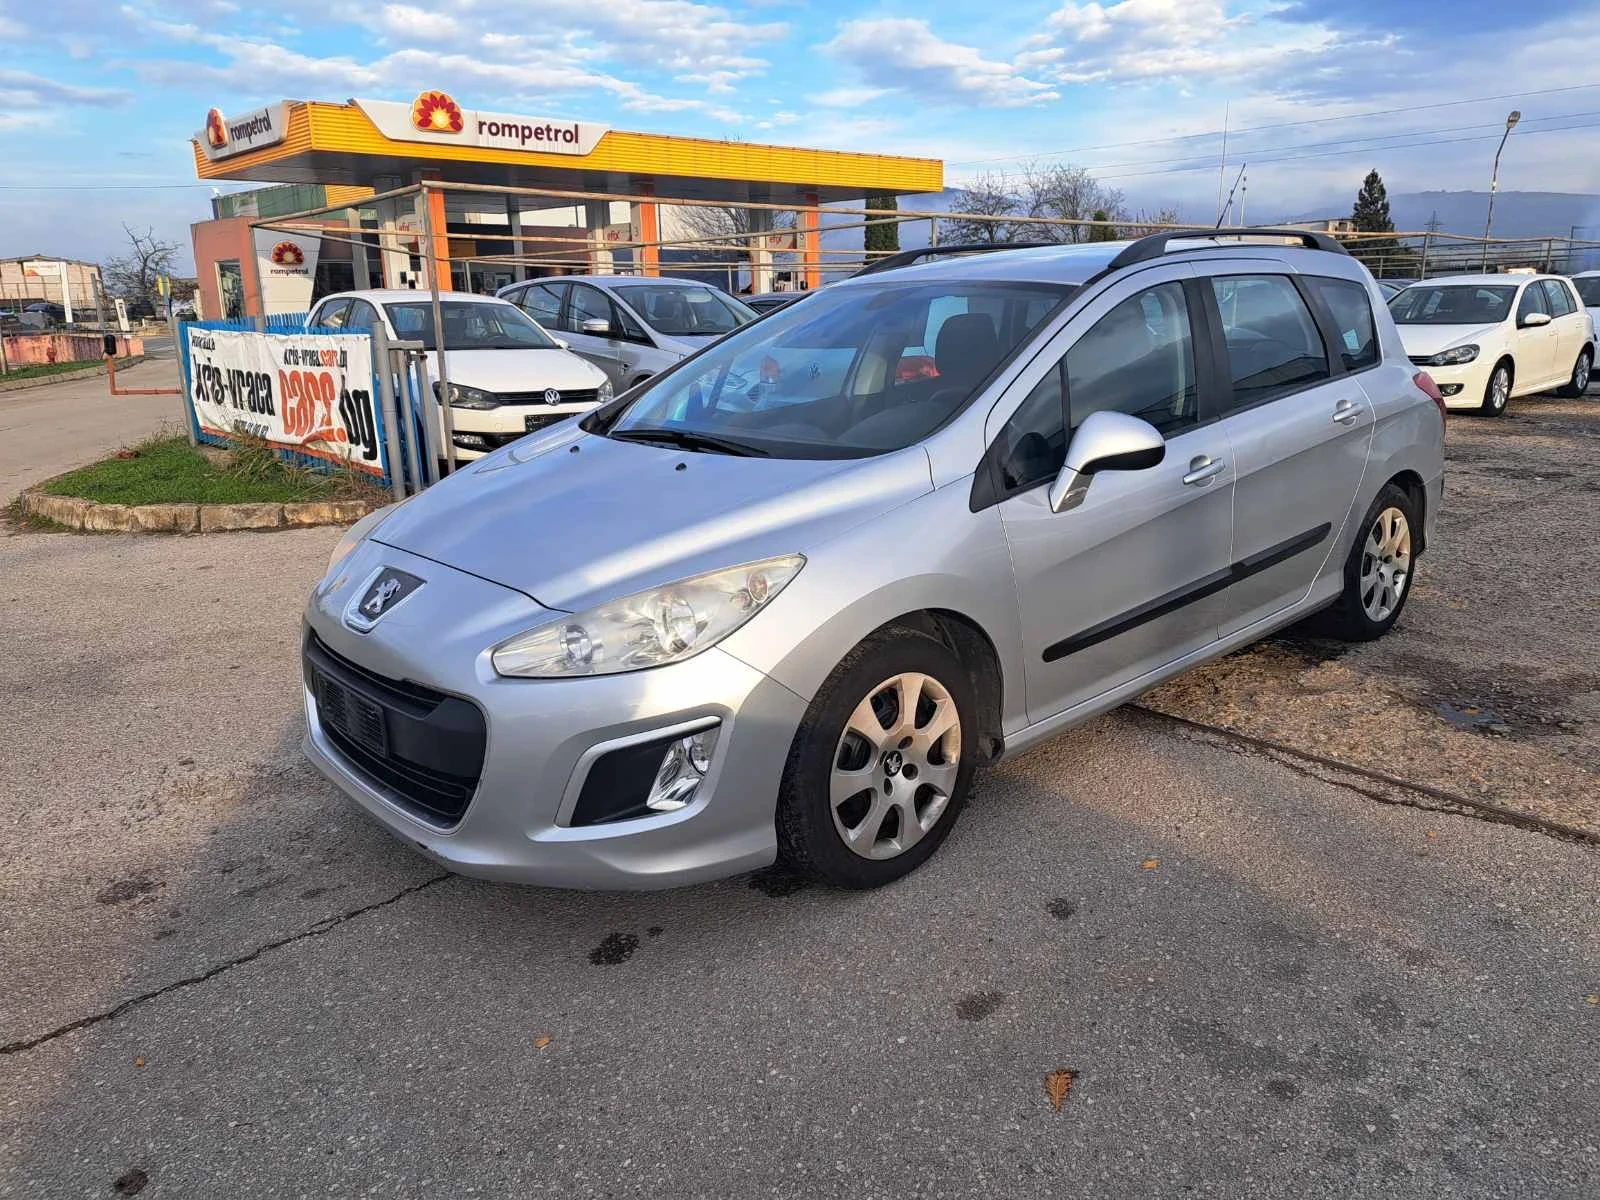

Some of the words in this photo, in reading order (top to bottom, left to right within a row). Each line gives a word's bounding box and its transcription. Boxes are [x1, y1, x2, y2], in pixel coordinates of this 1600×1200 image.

[230, 109, 272, 142] rompetrol
[477, 118, 579, 145] rompetrol
[193, 355, 275, 416] kris-vraca
